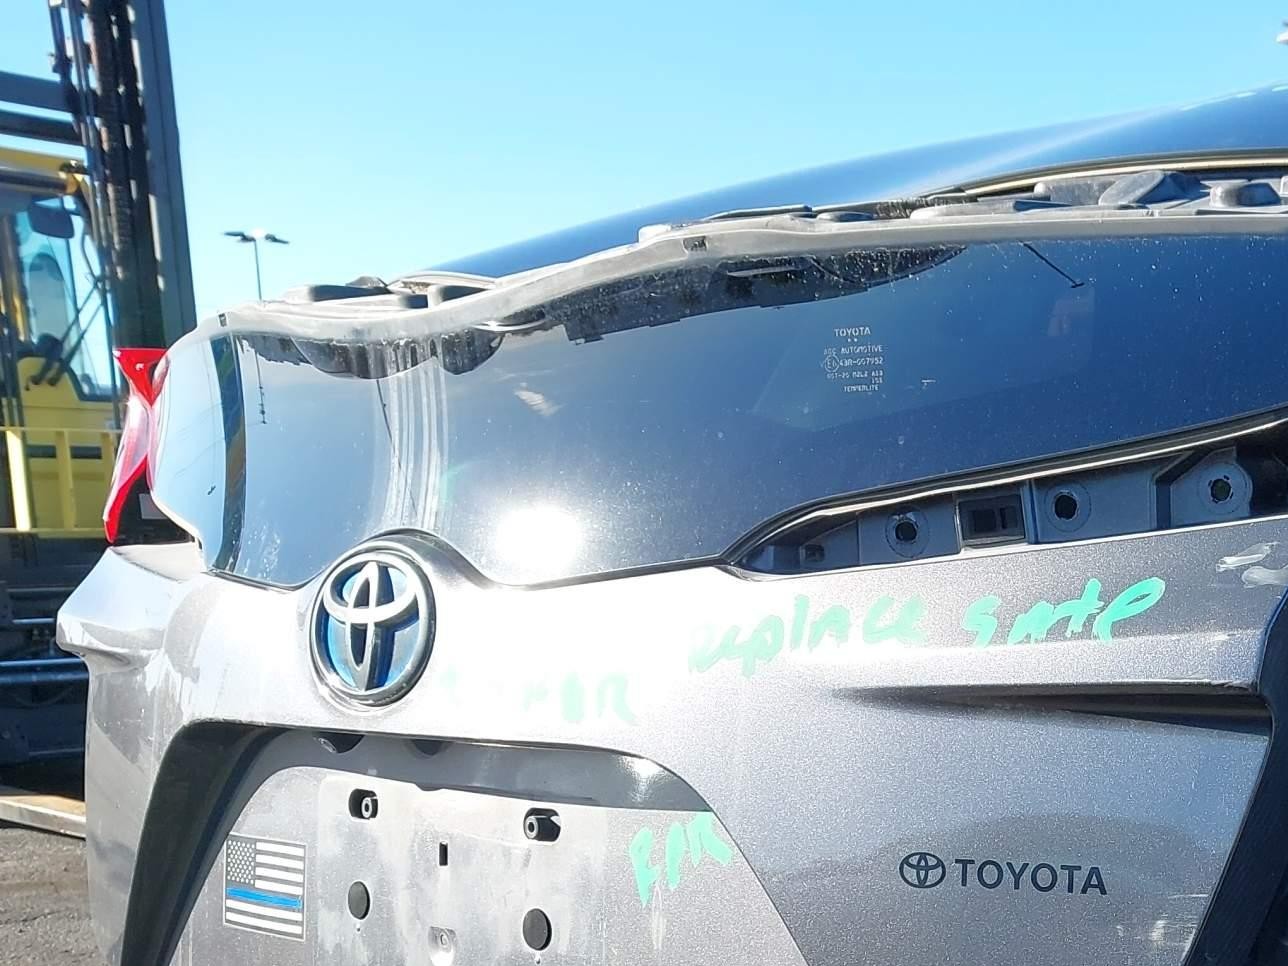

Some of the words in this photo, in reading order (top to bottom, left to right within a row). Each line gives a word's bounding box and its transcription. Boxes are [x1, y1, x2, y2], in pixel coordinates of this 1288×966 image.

[833, 326, 871, 337] TOYOTA
[840, 344, 883, 355] AUTOMOTIVE
[954, 858, 1108, 896] TOYOTA
